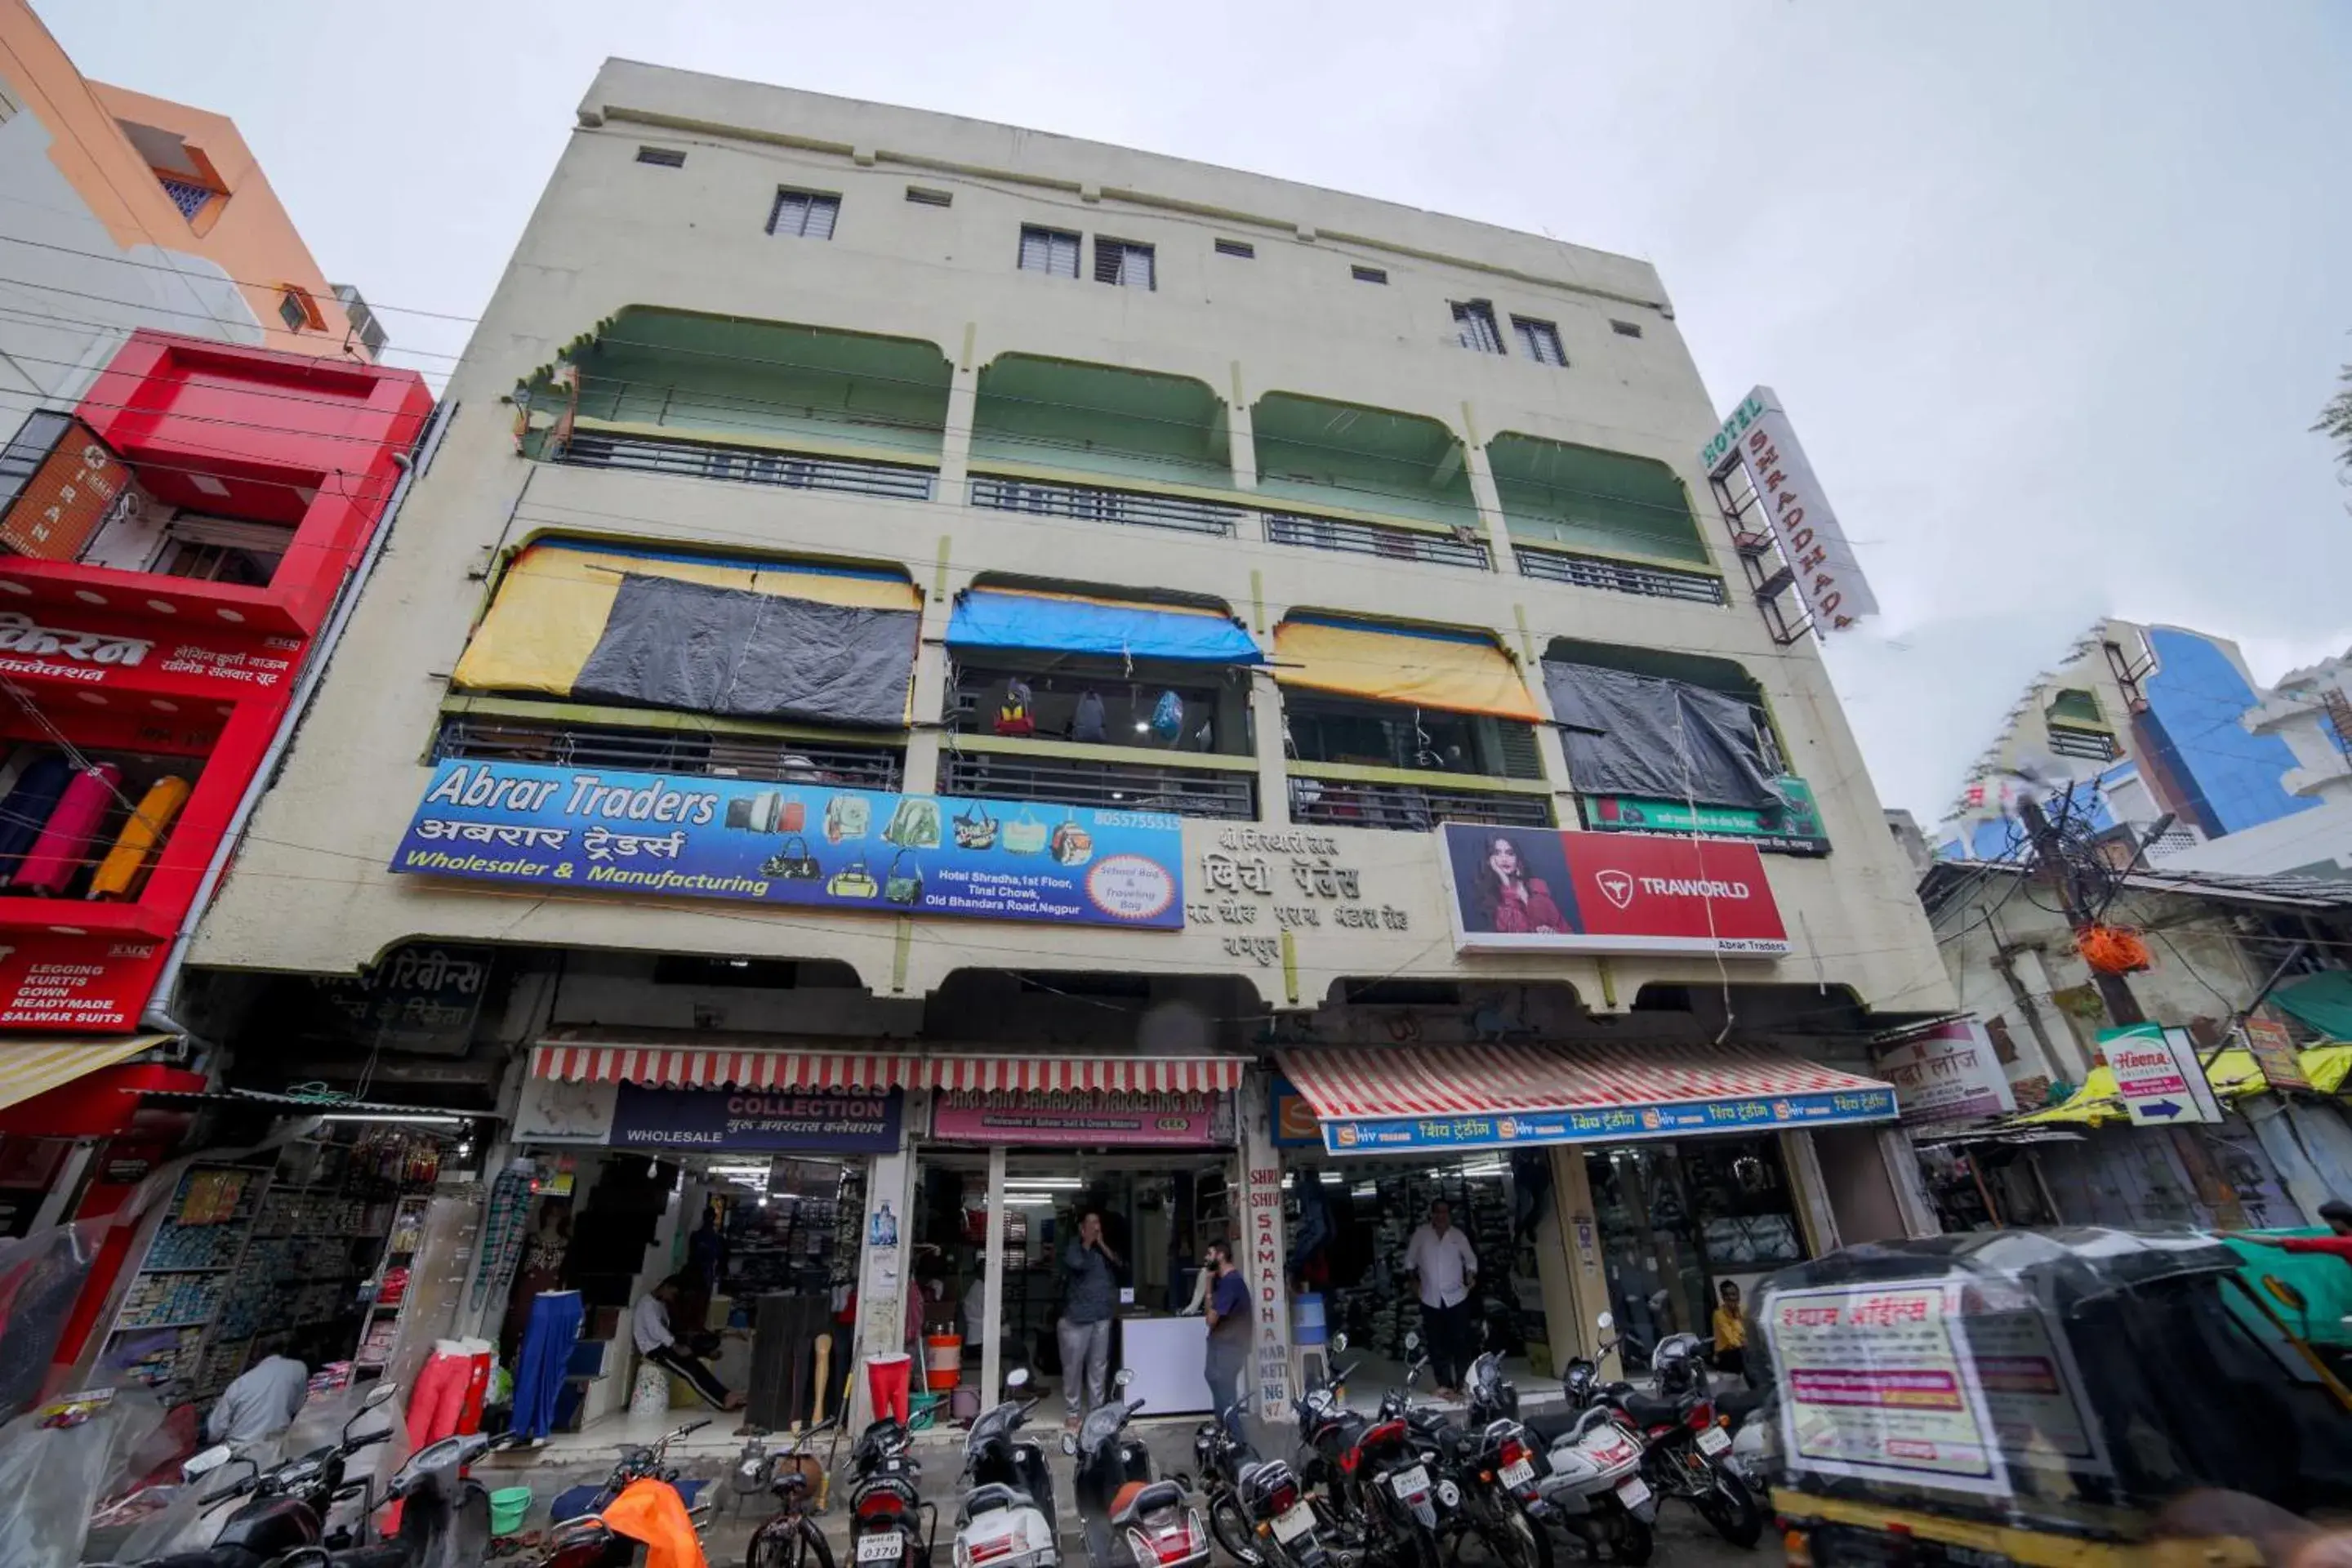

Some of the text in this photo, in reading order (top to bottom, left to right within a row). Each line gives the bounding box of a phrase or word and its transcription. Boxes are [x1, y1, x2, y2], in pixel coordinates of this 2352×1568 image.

[1703, 397, 1763, 469] HOTEL
[427, 765, 719, 826] Abrar Traders
[416, 818, 570, 851] अबरार
[406, 850, 769, 897] Wholesaler & Manufacturing
[1639, 877, 1749, 899] TRAWORLD
[925, 895, 947, 907] Old
[949, 897, 1004, 911] Bhandara
[29, 964, 105, 975] LEGGING
[24, 975, 87, 987] KURTIS
[18, 987, 69, 997] GOWN
[11, 998, 114, 1009] READYMADE
[1, 1011, 124, 1023] SALWAR SUITS
[727, 1098, 884, 1117] COLLECTION
[627, 1130, 723, 1143] WHOLESALE
[1250, 1169, 1278, 1185] SHRI
[1251, 1192, 1279, 1208] SHIV
[1264, 1383, 1284, 1400] NG
